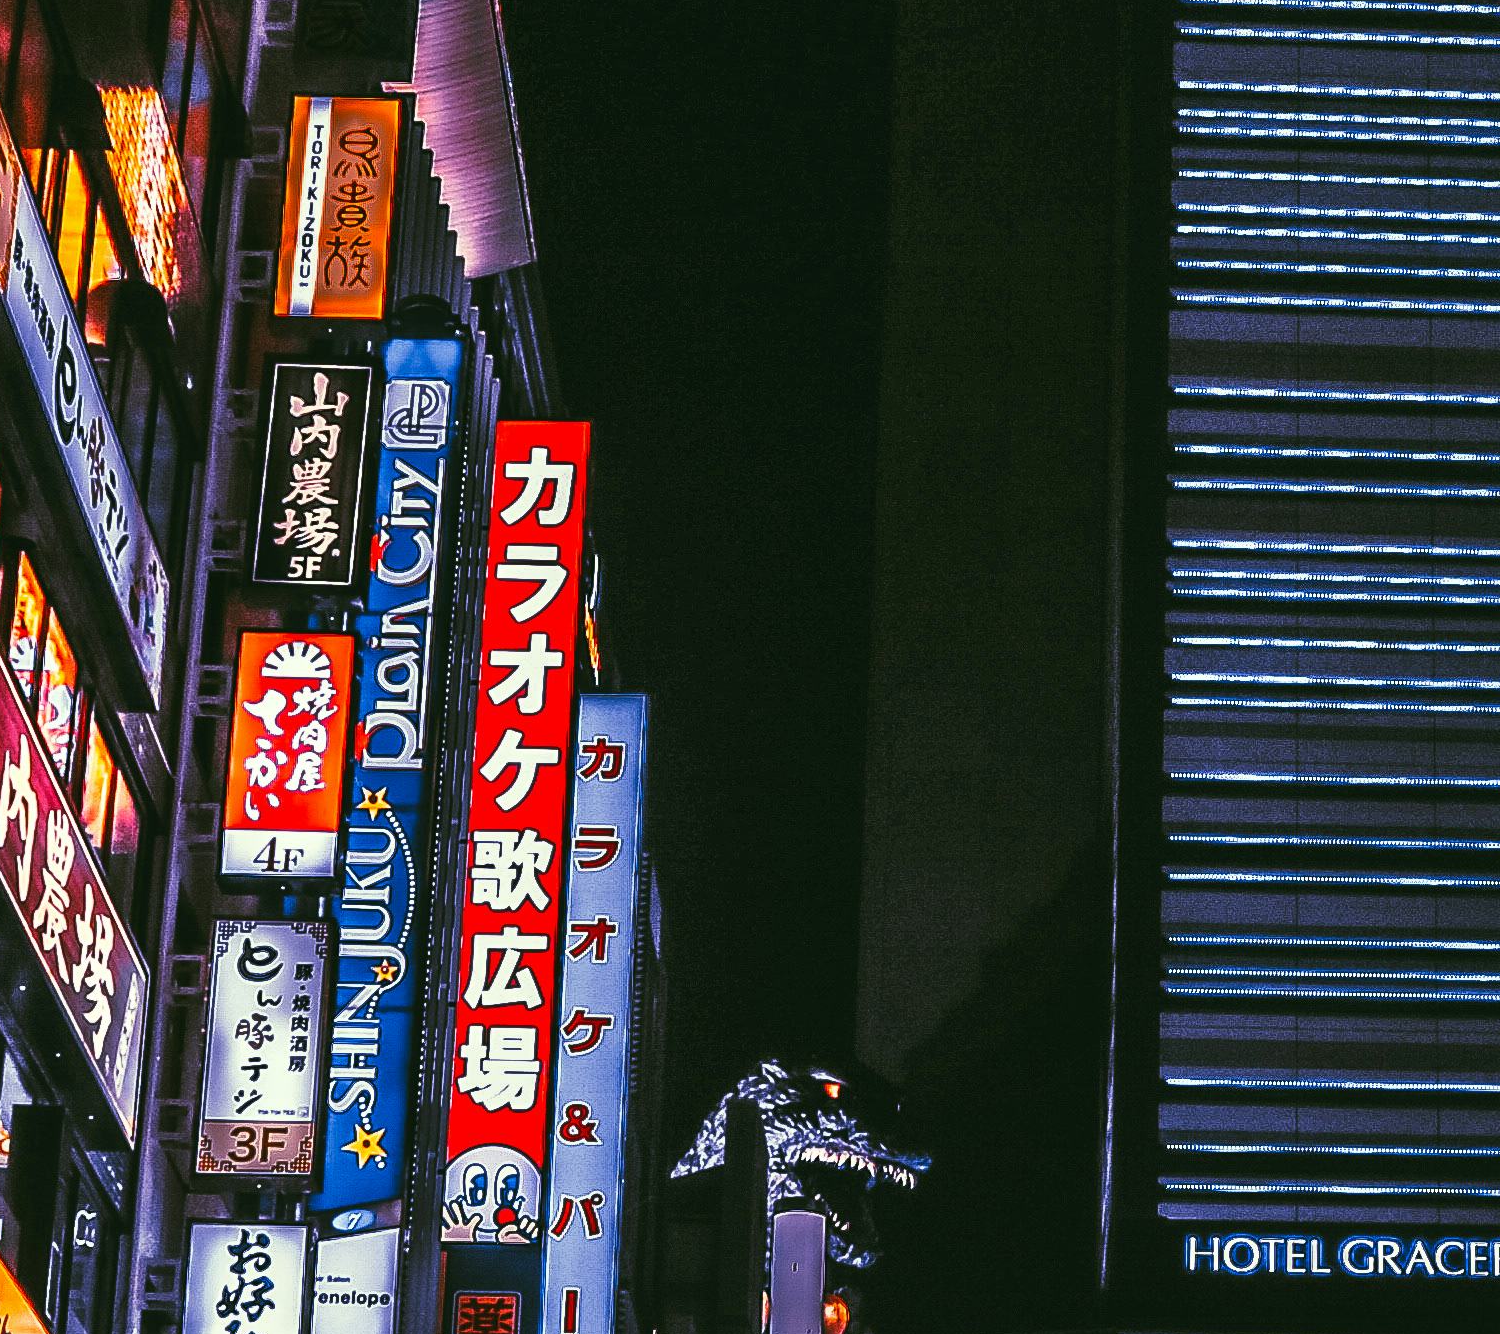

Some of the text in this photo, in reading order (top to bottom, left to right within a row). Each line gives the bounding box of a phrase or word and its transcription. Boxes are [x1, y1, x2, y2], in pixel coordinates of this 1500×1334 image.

[298, 124, 326, 280] TORIKIZOKU
[323, 126, 380, 289] 鳥貴族
[273, 372, 350, 556] 山内農場
[286, 556, 322, 580] 5F
[240, 693, 290, 822] さかい
[290, 679, 340, 793] 焼肉屋
[455, 447, 575, 1114] カラオケ歌広場
[252, 835, 306, 874] 4F
[328, 827, 408, 1115] SHINJUKU
[228, 1126, 290, 1164] 3F
[345, 1211, 363, 1229] 7
[1187, 1236, 1331, 1274] HOTEL
